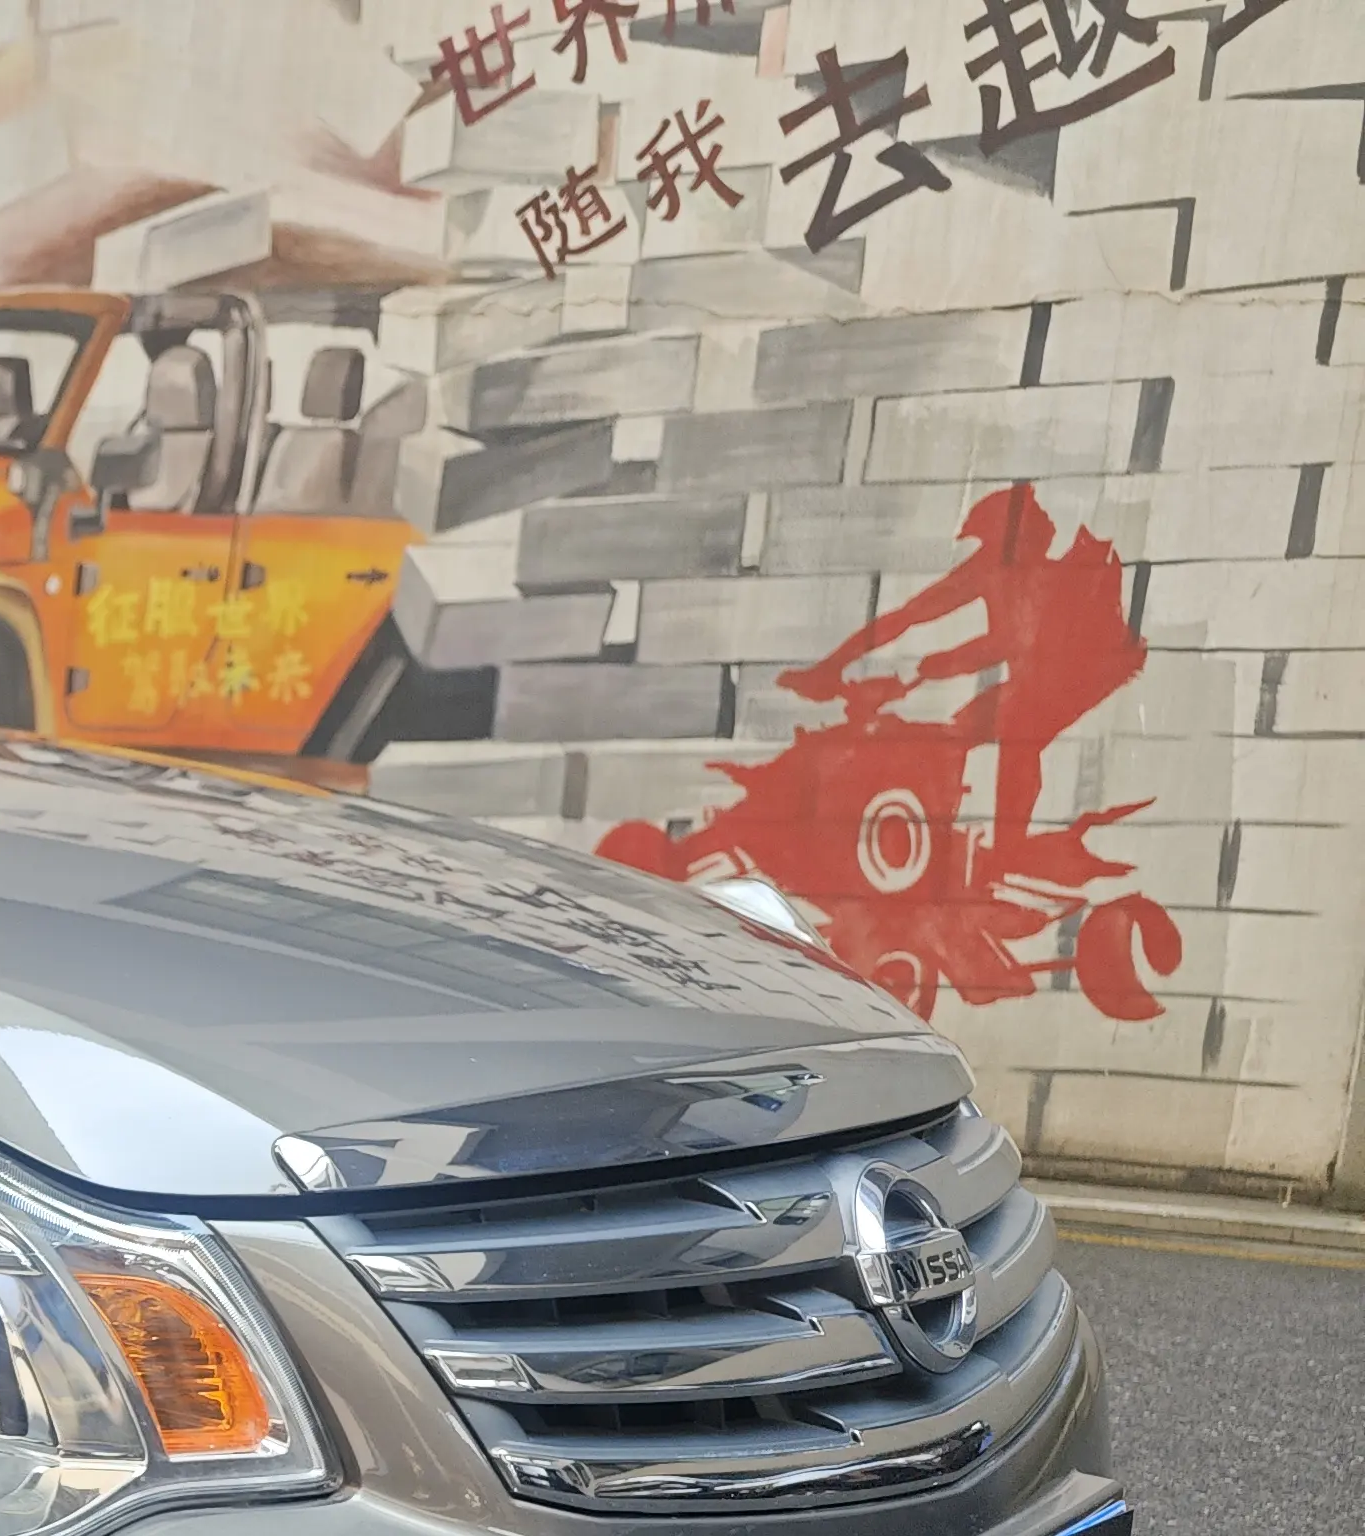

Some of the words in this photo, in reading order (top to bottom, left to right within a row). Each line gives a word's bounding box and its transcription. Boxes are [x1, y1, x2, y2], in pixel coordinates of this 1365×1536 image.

[515, 0, 1289, 280] 随我去越
[86, 577, 309, 648] 征服世界
[889, 1244, 974, 1291] NISSA
